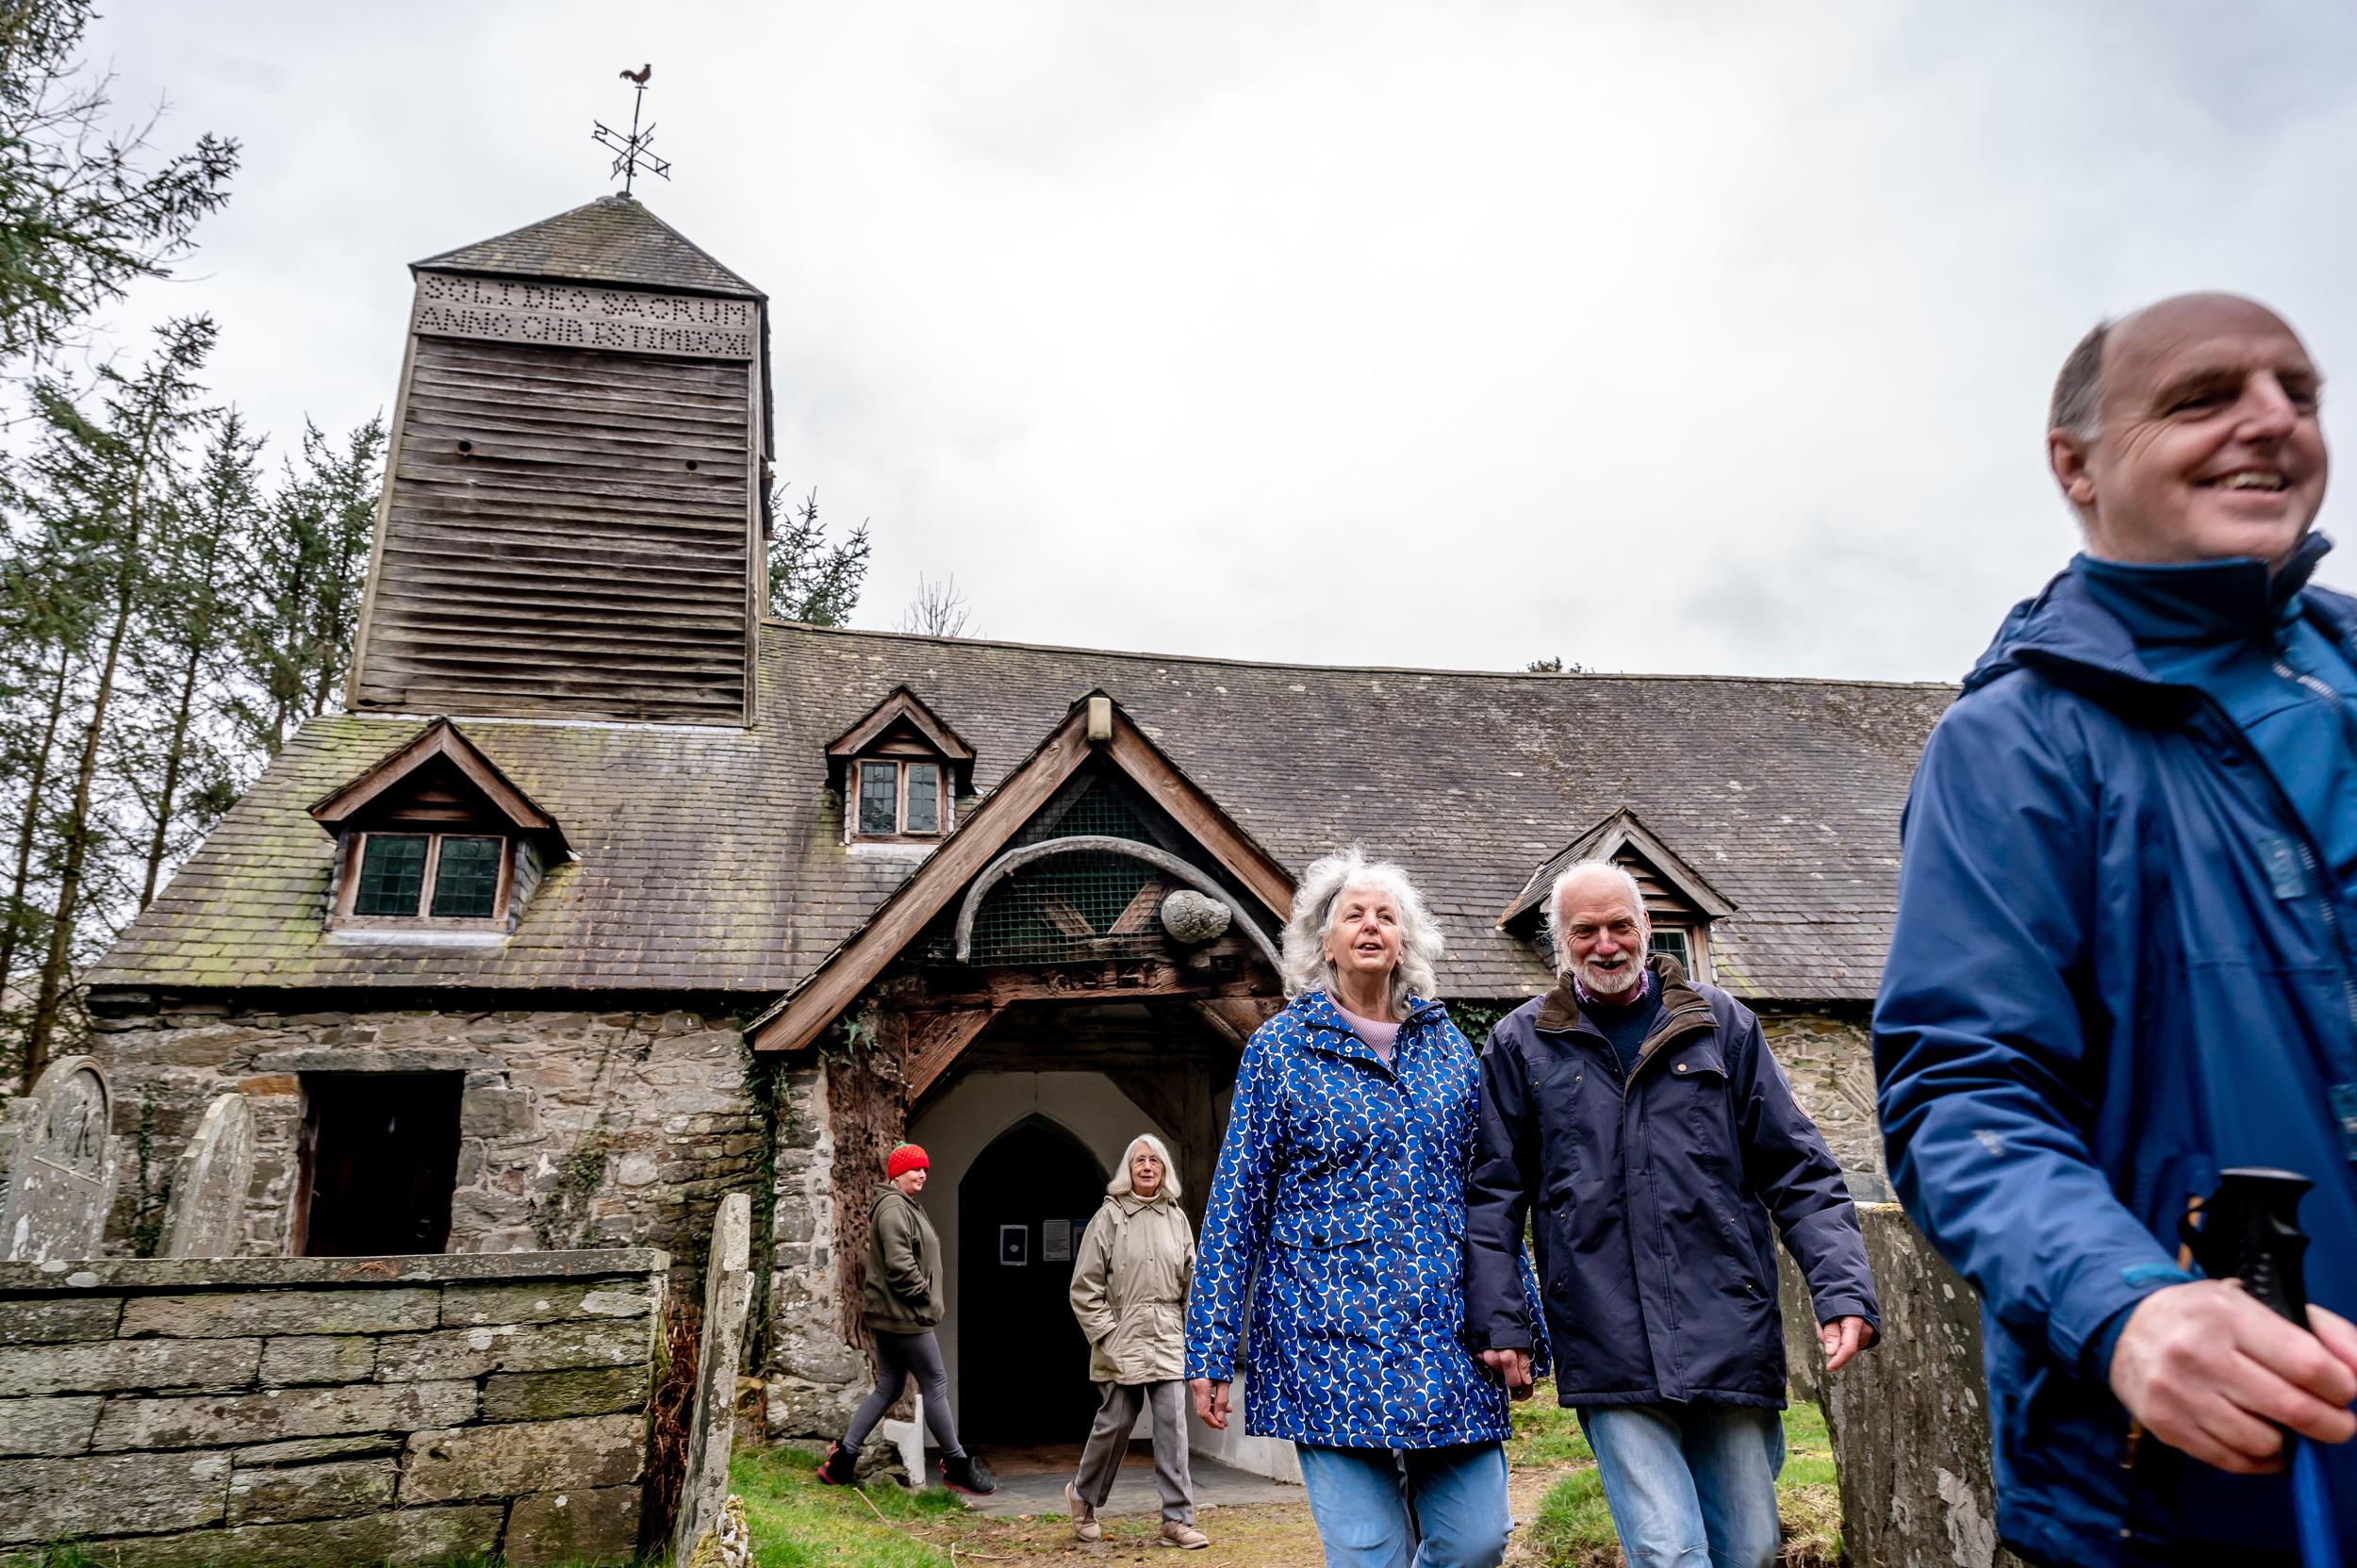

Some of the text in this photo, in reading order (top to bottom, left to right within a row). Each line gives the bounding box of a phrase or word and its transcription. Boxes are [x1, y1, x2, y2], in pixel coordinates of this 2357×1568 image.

[424, 276, 746, 326] SOLI DEO SACRUM
[417, 306, 512, 337] ANNO
[520, 316, 658, 349] CHRISTI
